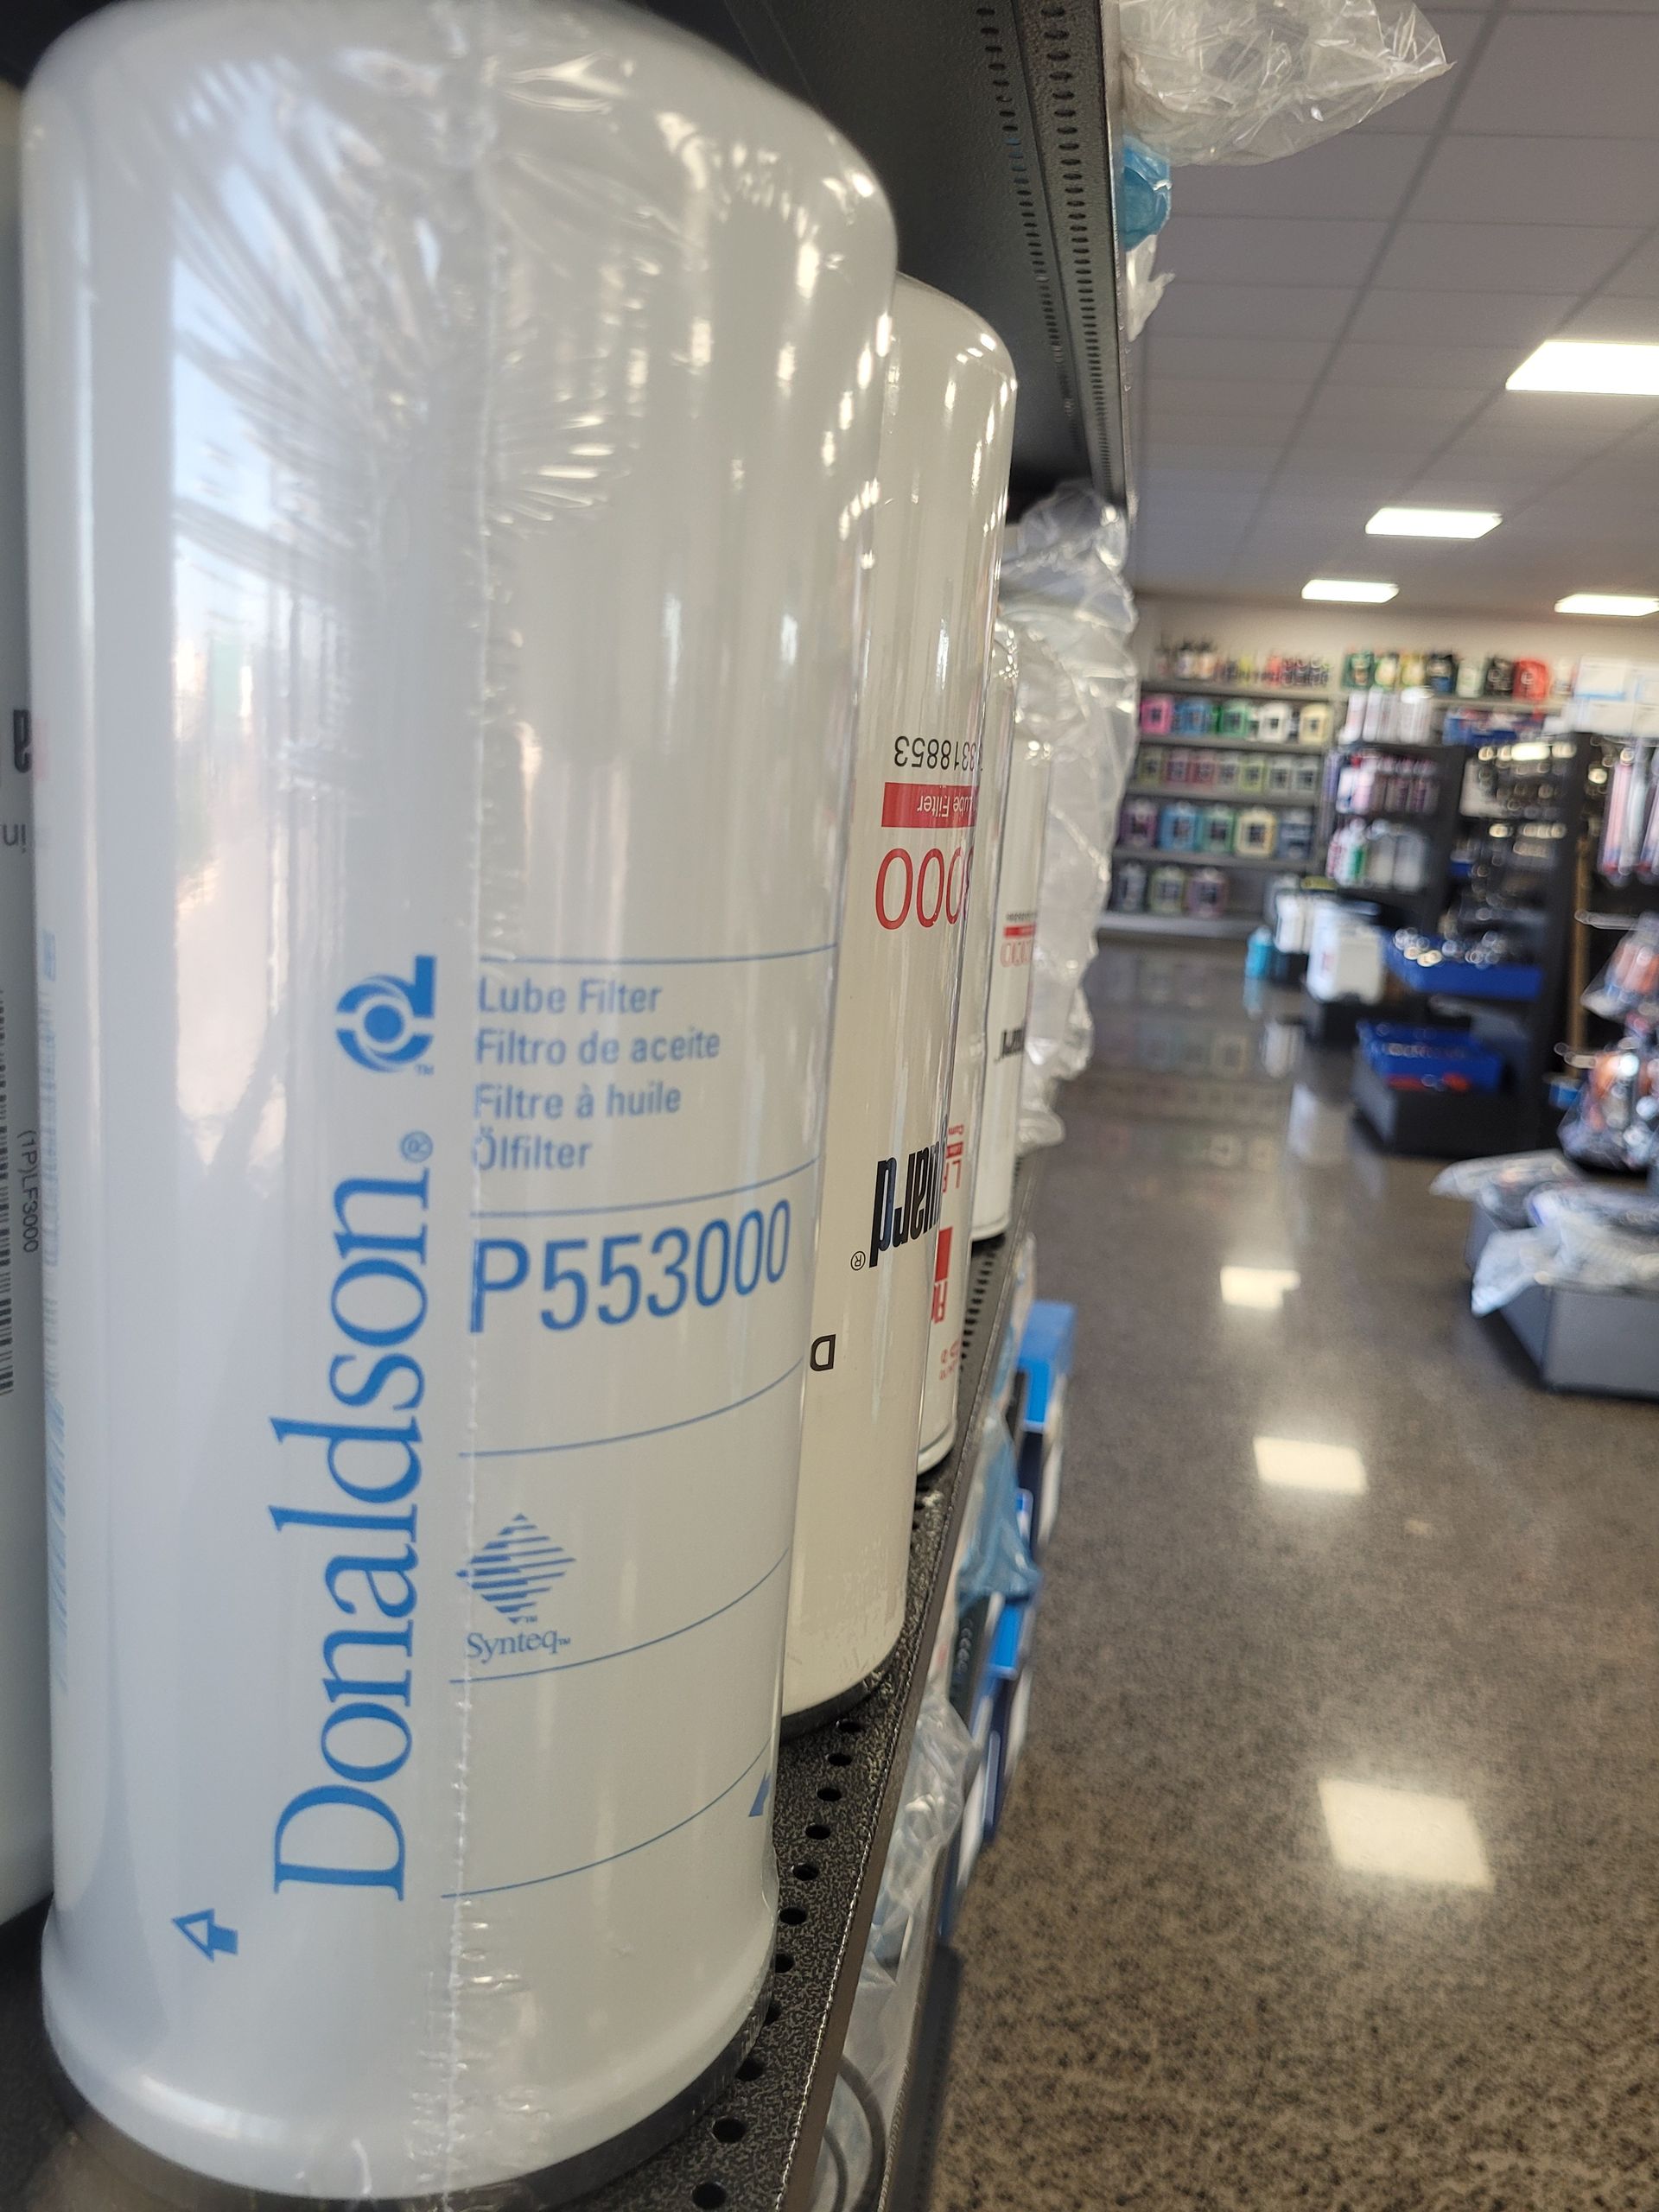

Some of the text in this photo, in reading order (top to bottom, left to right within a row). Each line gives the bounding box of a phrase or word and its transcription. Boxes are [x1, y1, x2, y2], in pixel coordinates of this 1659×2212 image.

[917, 795, 949, 817] Filter
[477, 976, 663, 1014] Lube Filter
[474, 1027, 721, 1065] Filtro de aceite
[473, 1082, 681, 1121] Filtre à huile
[472, 1127, 592, 1171] Ölfilter
[469, 1198, 791, 1335] P553000
